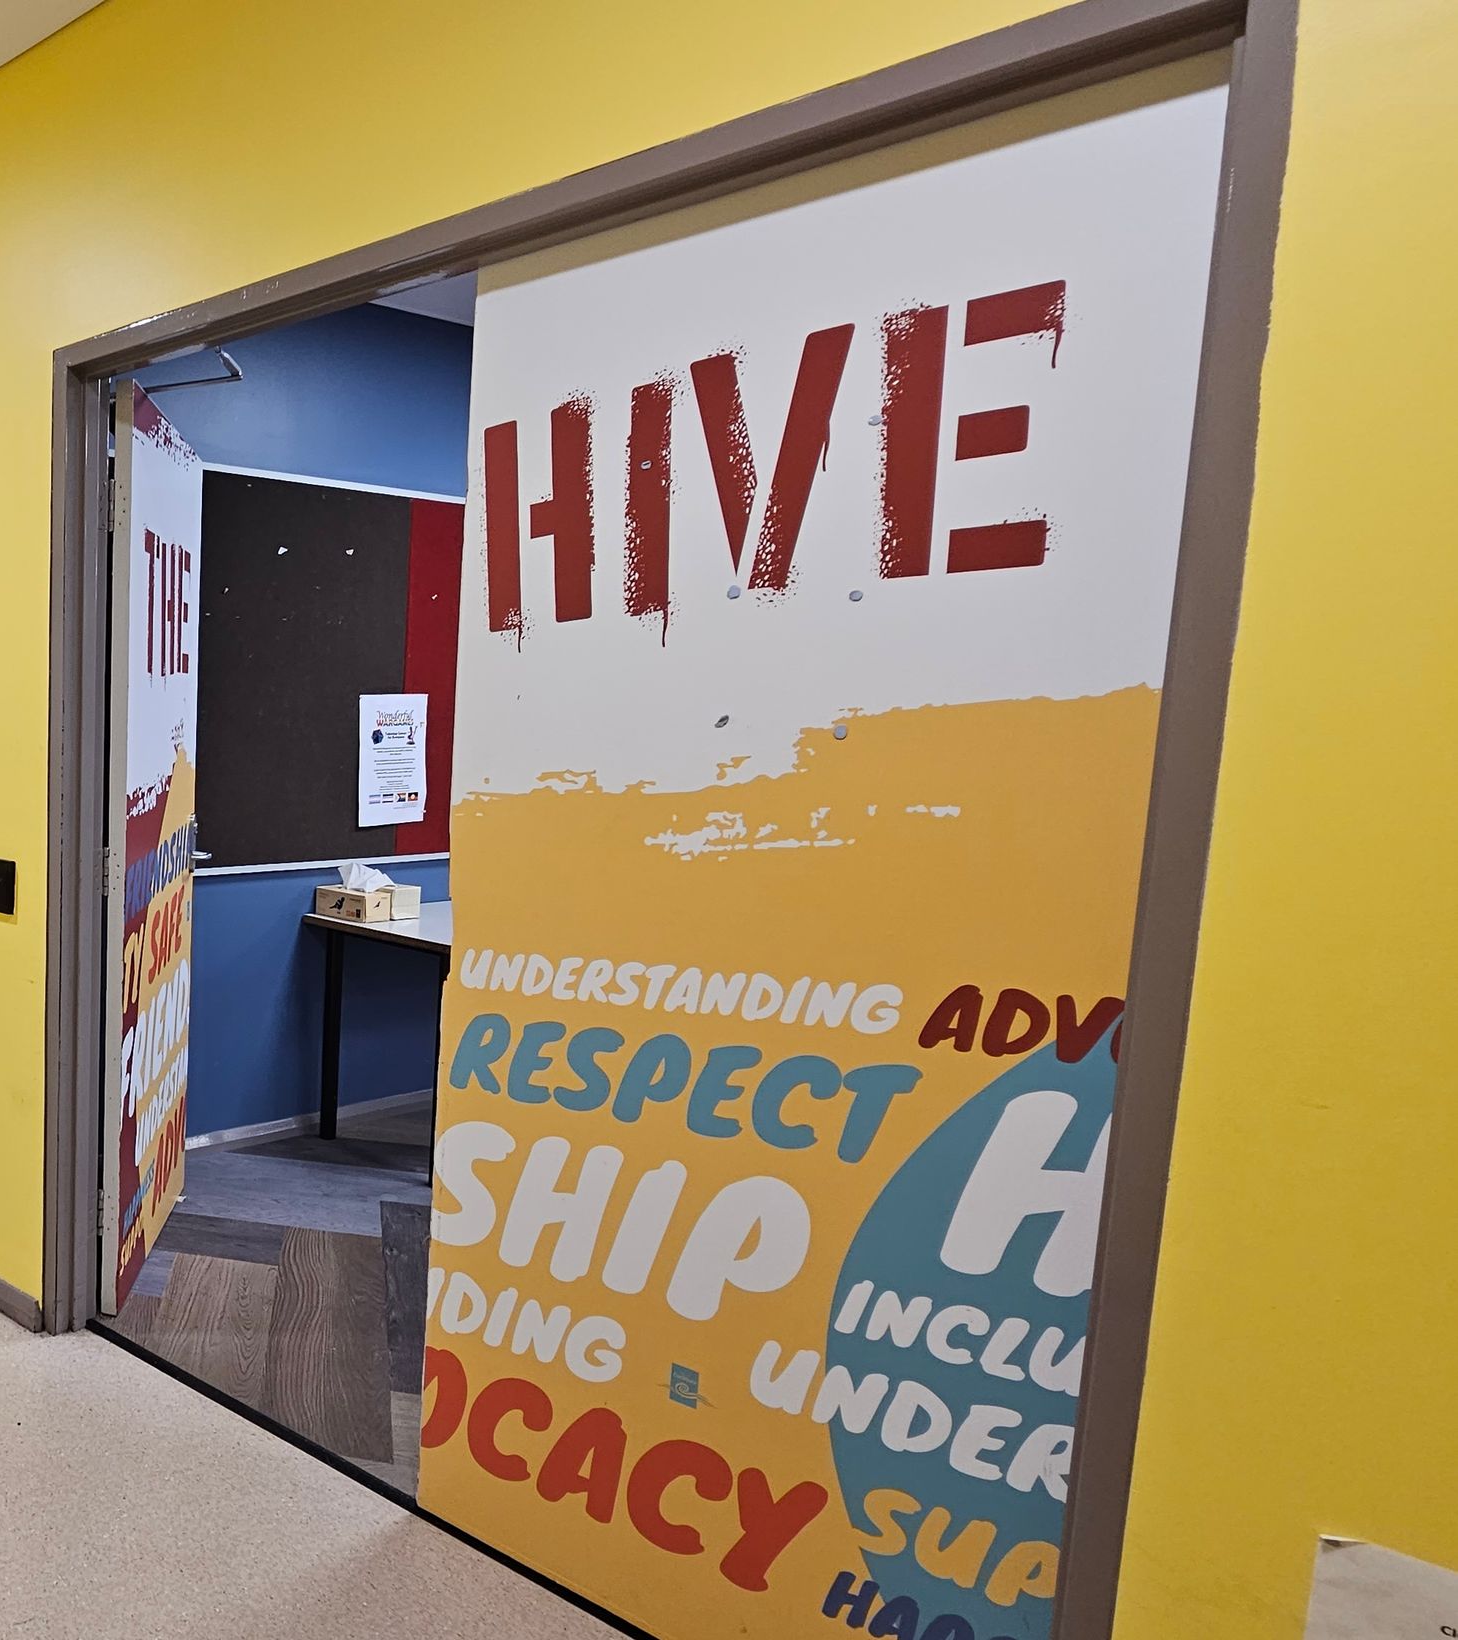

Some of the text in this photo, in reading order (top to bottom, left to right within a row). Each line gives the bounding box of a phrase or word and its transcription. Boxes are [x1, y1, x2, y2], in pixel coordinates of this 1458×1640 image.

[484, 279, 1068, 652] HIVE
[144, 527, 191, 680] THE
[148, 885, 185, 984] SAFE
[459, 948, 903, 1035] UNDERSTANDING
[120, 958, 189, 1131] FRIEND
[449, 1013, 922, 1164] RESPECT
[918, 984, 1126, 1064] ADV
[431, 1121, 811, 1321] SHIP
[749, 1339, 1077, 1503] UNDER
[851, 1487, 1061, 1607] SUP
